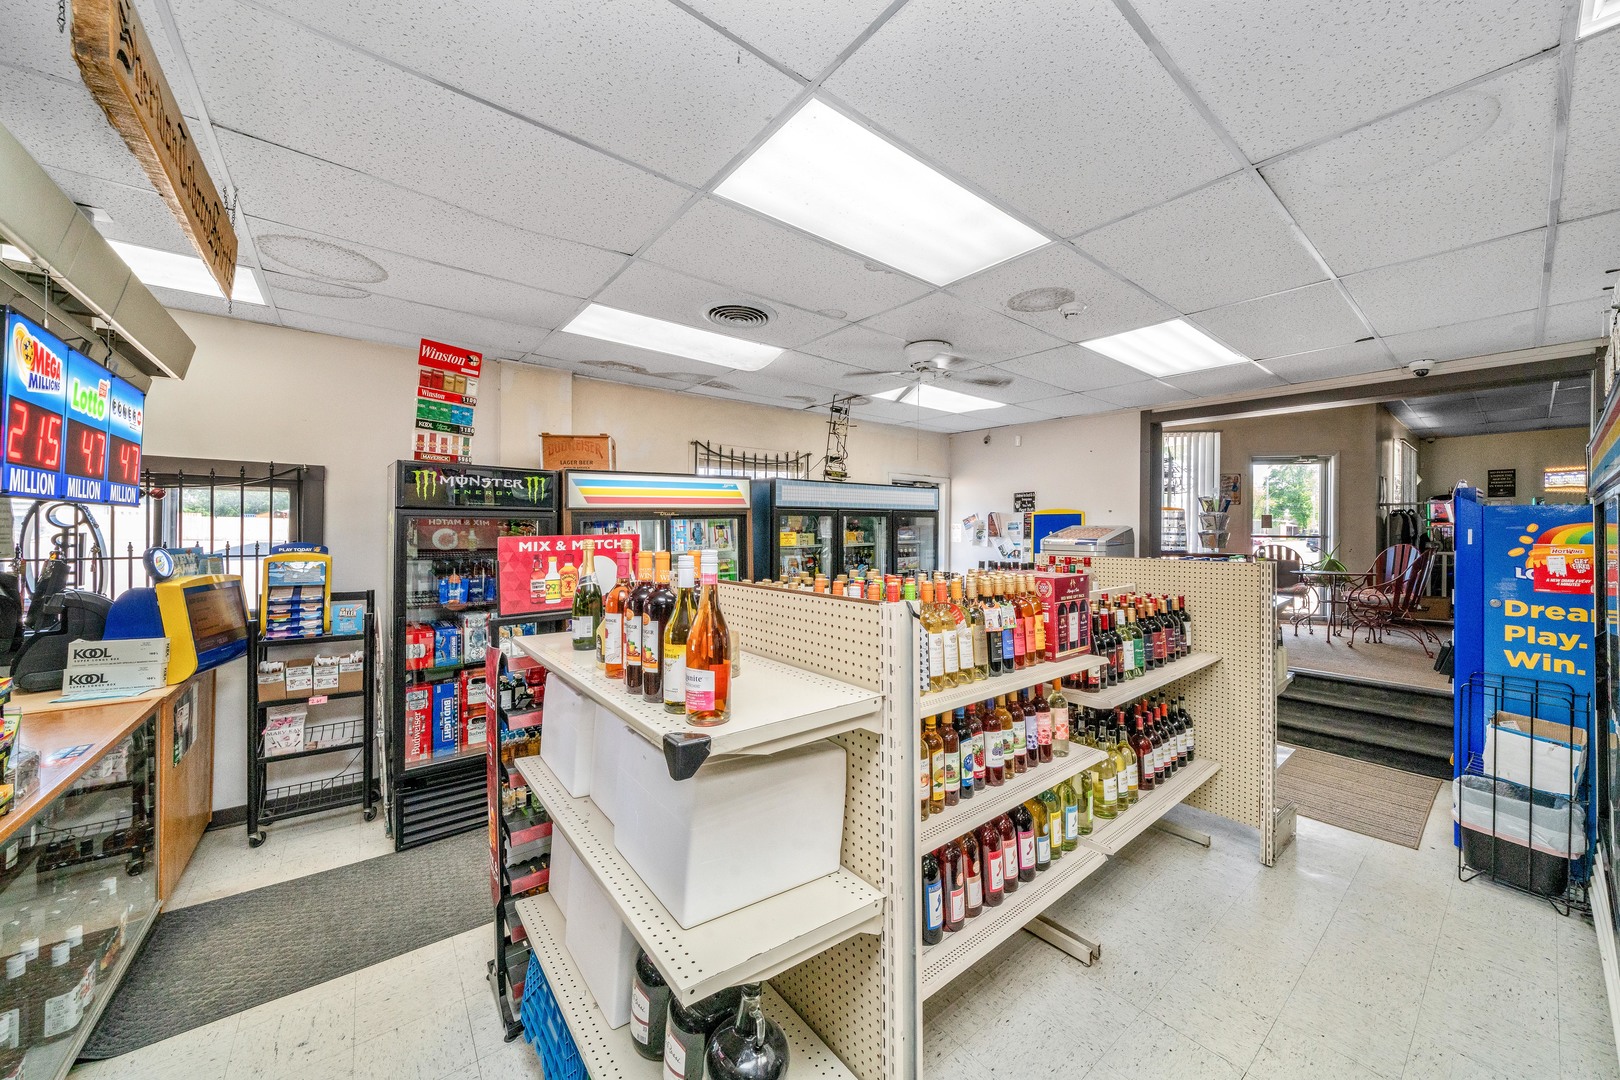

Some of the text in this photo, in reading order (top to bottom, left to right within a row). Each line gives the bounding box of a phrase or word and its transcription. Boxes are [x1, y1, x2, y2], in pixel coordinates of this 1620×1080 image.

[31, 341, 61, 382] MEGA
[421, 344, 466, 366] Winston
[28, 373, 60, 391] MILLIONS
[73, 380, 105, 418] Lotto
[421, 388, 446, 400] Winston
[8, 403, 61, 466] 215
[547, 440, 604, 459] BUDWEISER
[9, 468, 55, 495] MILLION
[67, 478, 101, 500] MILLION
[439, 474, 524, 489] MONSTER
[110, 485, 136, 504] MILLION
[518, 539, 624, 553] MIX & MTCH
[1504, 625, 1588, 650] Play.
[73, 647, 112, 660] KOOL
[1503, 650, 1586, 676] Win.
[69, 673, 109, 686] KOOL
[410, 711, 422, 756] Budweiser
